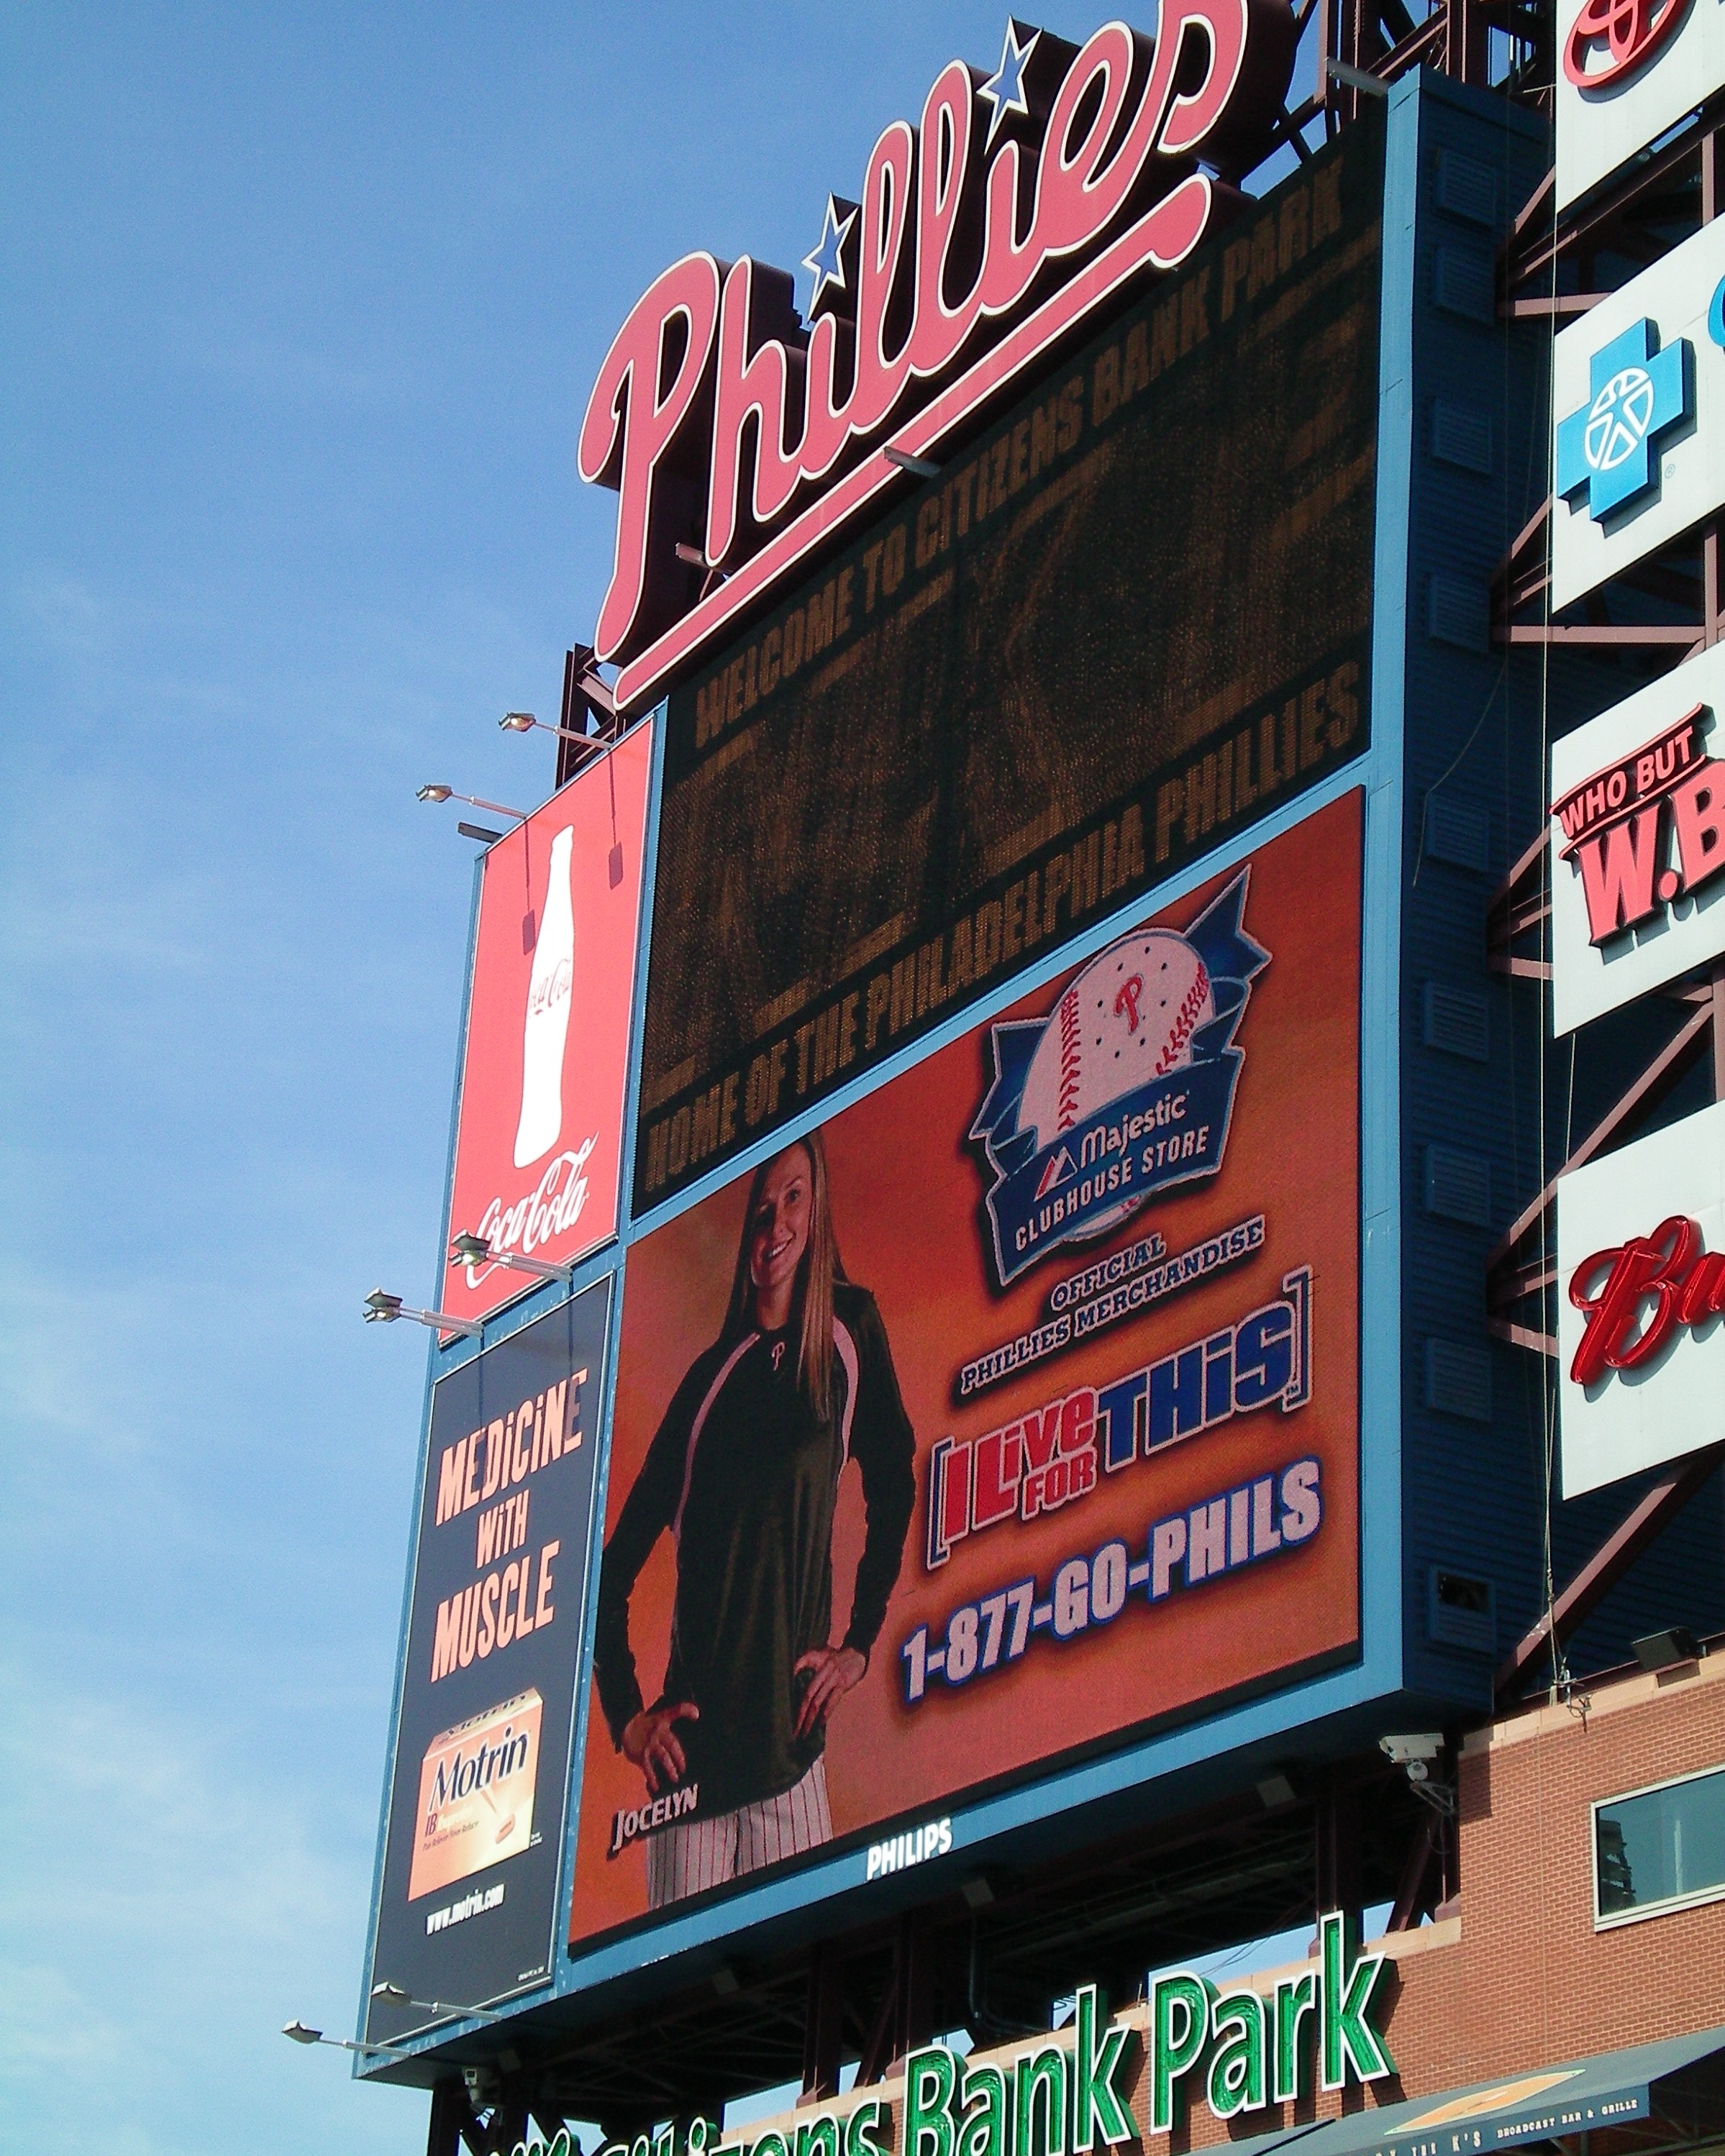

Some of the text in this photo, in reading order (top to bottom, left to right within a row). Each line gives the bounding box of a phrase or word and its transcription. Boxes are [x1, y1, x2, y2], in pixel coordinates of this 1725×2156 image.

[577, 0, 1249, 663] Phillies
[696, 153, 1344, 749] WELCOME TO CITIZENS BANK PARK
[1560, 725, 1694, 839] WHO BUT
[645, 660, 1360, 1192] HOME OF THE PHILADELPHIA PHILLIES
[1080, 1090, 1187, 1170] Majestic
[1015, 1126, 1209, 1252] CLUBHOUSE STORE
[961, 1214, 1266, 1395] PHILLIES MERCHANDISE
[1051, 1232, 1167, 1311] OFFICIAL
[1021, 1445, 1097, 1521] FOR
[431, 1539, 560, 1683] MUSCLE
[903, 1456, 1322, 1702] 1-877-GO-PHILS
[428, 1726, 530, 1813] Motrin
[612, 1783, 698, 1853] JOCELYN
[866, 1817, 953, 1881] PHILIPS
[427, 1883, 505, 1936] www.motrin.com
[903, 1909, 1394, 2156] Bank Park
[1496, 2116, 1555, 2139] BROADCAST
[1561, 2111, 1583, 2124] BAR
[1601, 2098, 1639, 2116] GRILLE
